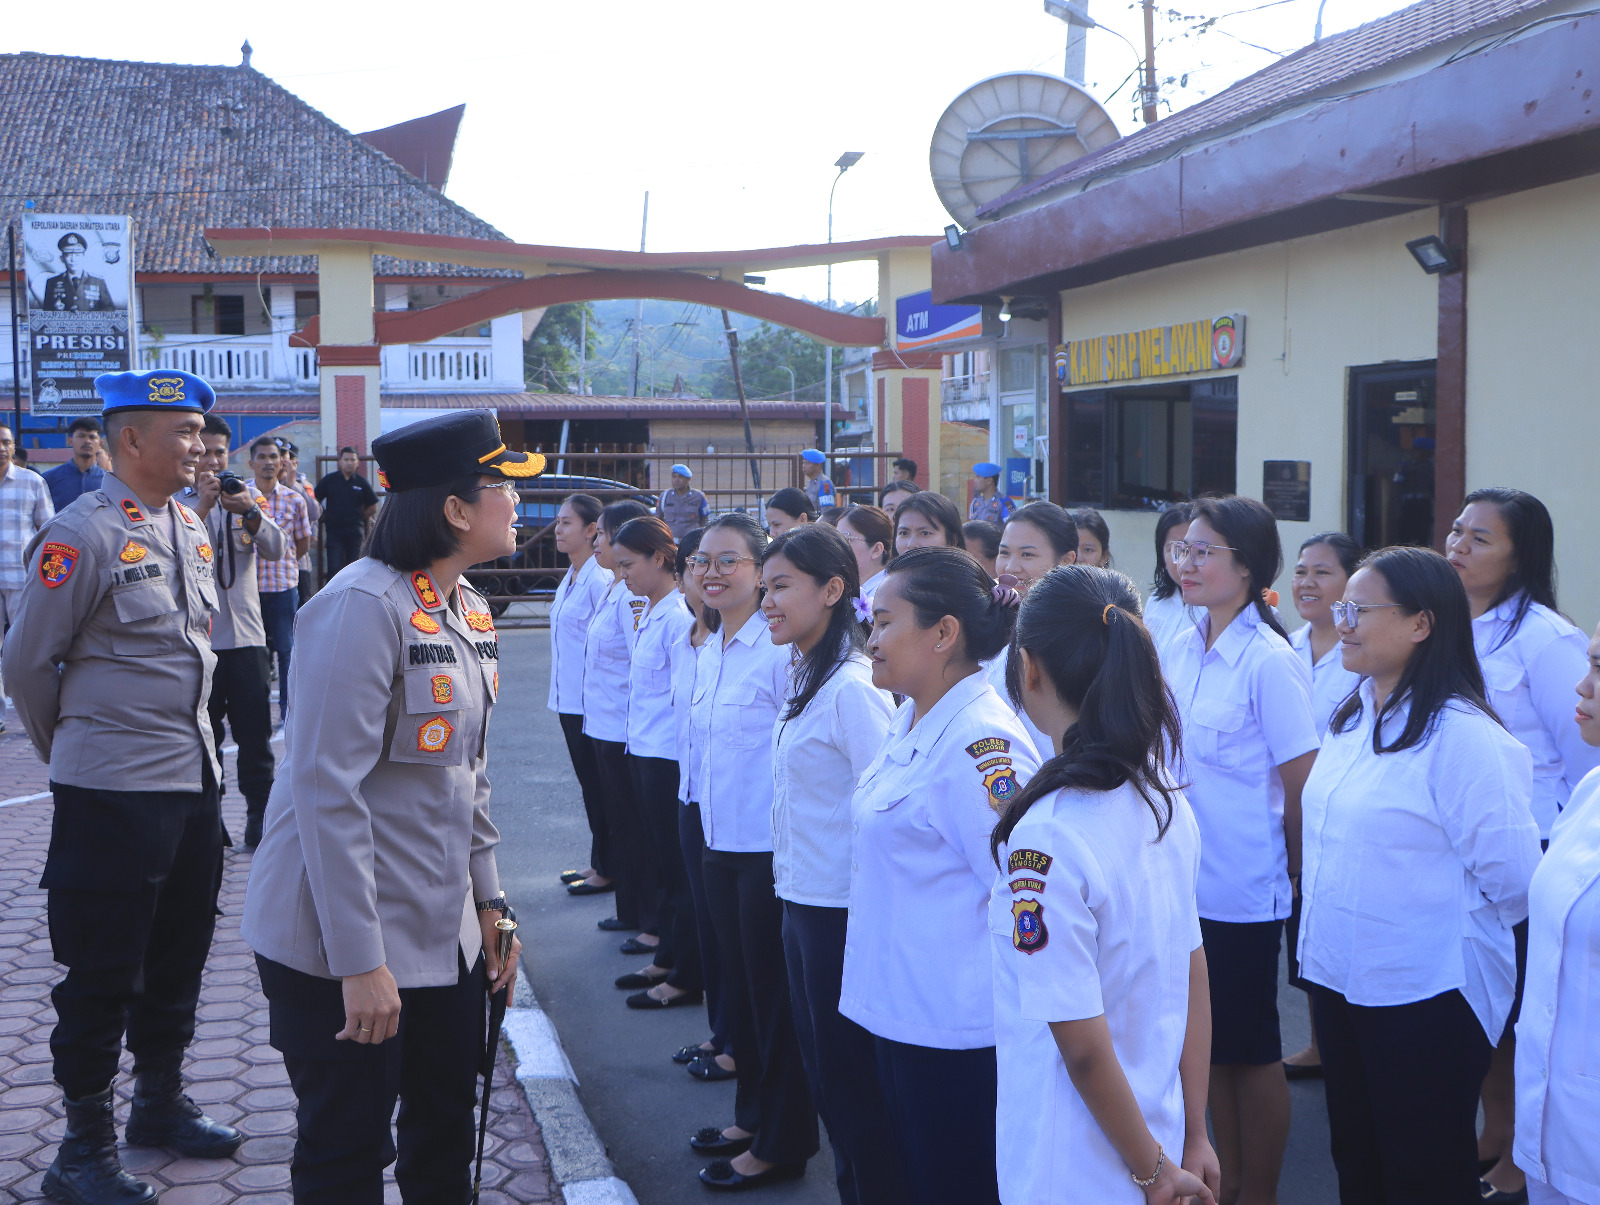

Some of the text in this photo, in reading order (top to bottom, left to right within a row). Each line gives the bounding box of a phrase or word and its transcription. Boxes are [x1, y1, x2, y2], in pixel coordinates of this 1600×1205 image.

[31, 221, 120, 231] KEPOLISIAN DAERAH SUMATERA UTARA
[906, 310, 929, 333] ATM
[36, 335, 125, 350] PRESISI
[1070, 319, 1212, 385] KAMI SIAP MELAYANI
[61, 389, 93, 399] BERSAMA
[409, 643, 458, 665] RINTAR
[972, 738, 1005, 751] POLRES
[975, 744, 1005, 756] SAMOSIR
[1010, 851, 1048, 866] POLRES
[1011, 860, 1042, 869] SAMOSIR
